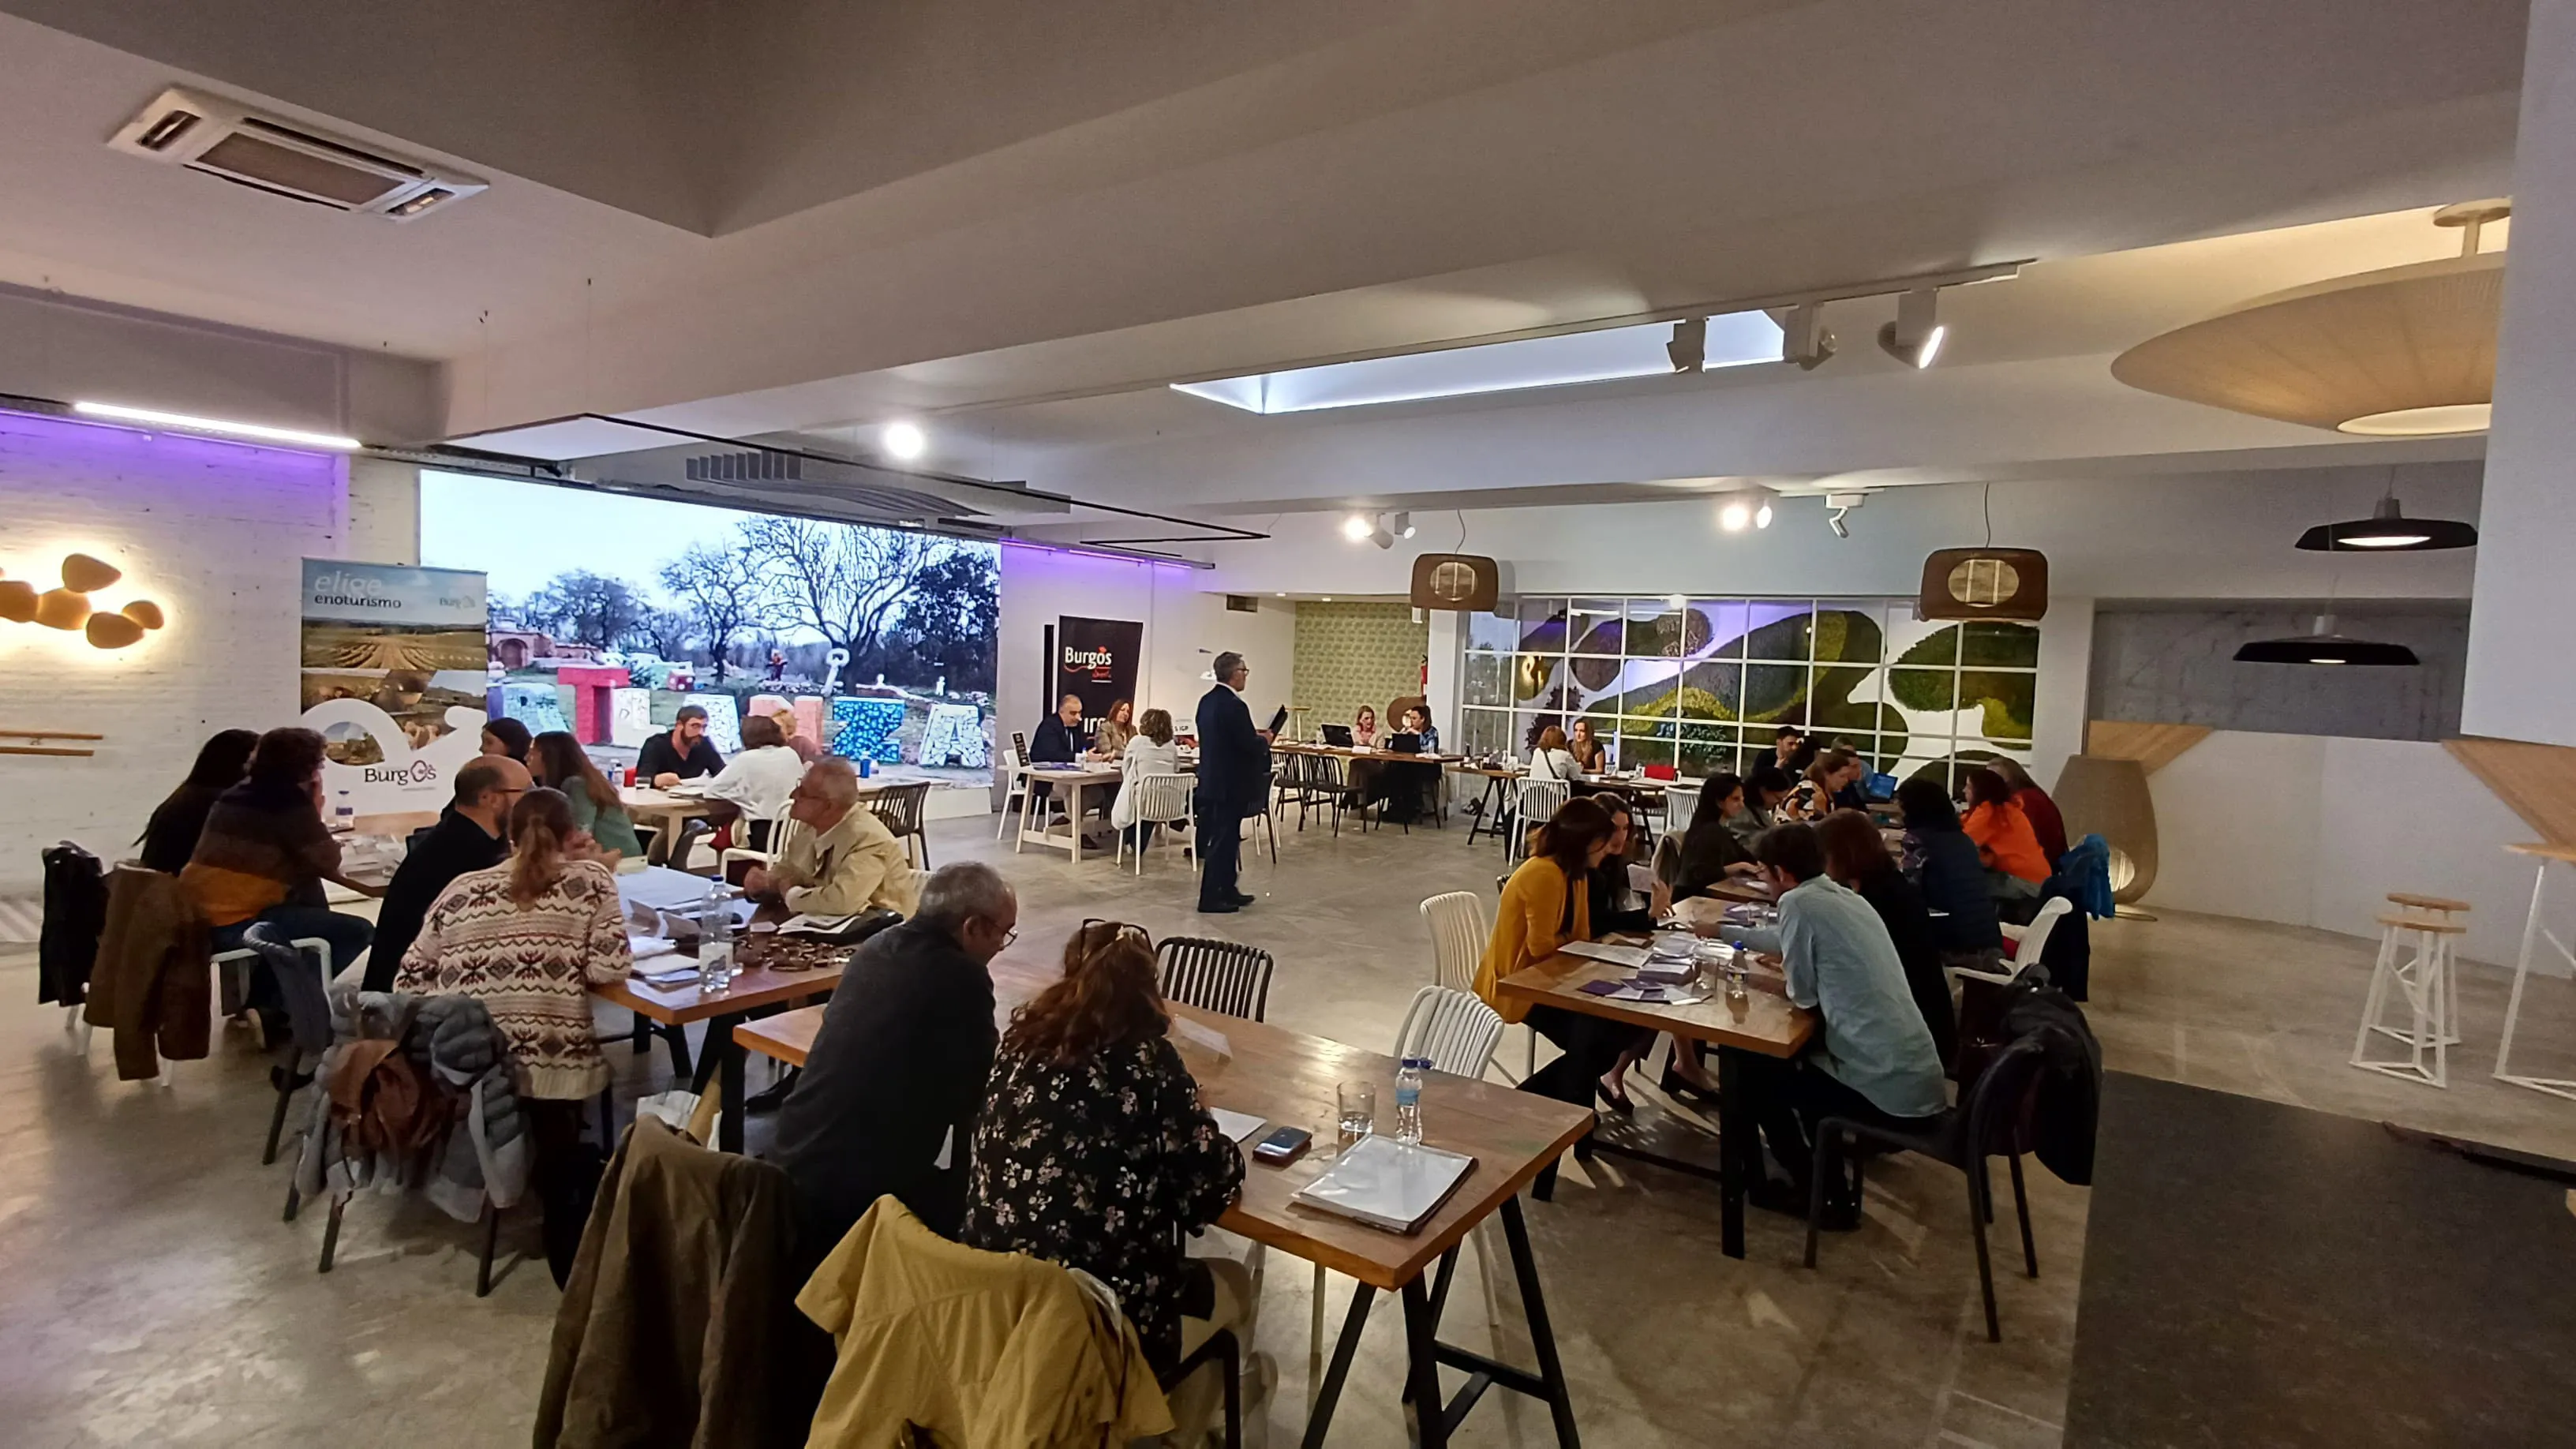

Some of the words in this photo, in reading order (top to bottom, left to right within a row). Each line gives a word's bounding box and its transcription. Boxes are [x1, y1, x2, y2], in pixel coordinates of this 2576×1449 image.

[316, 571, 382, 598] elige
[314, 594, 402, 609] enoturismo
[1065, 646, 1112, 670] Burgos
[364, 759, 436, 786] Burgos
